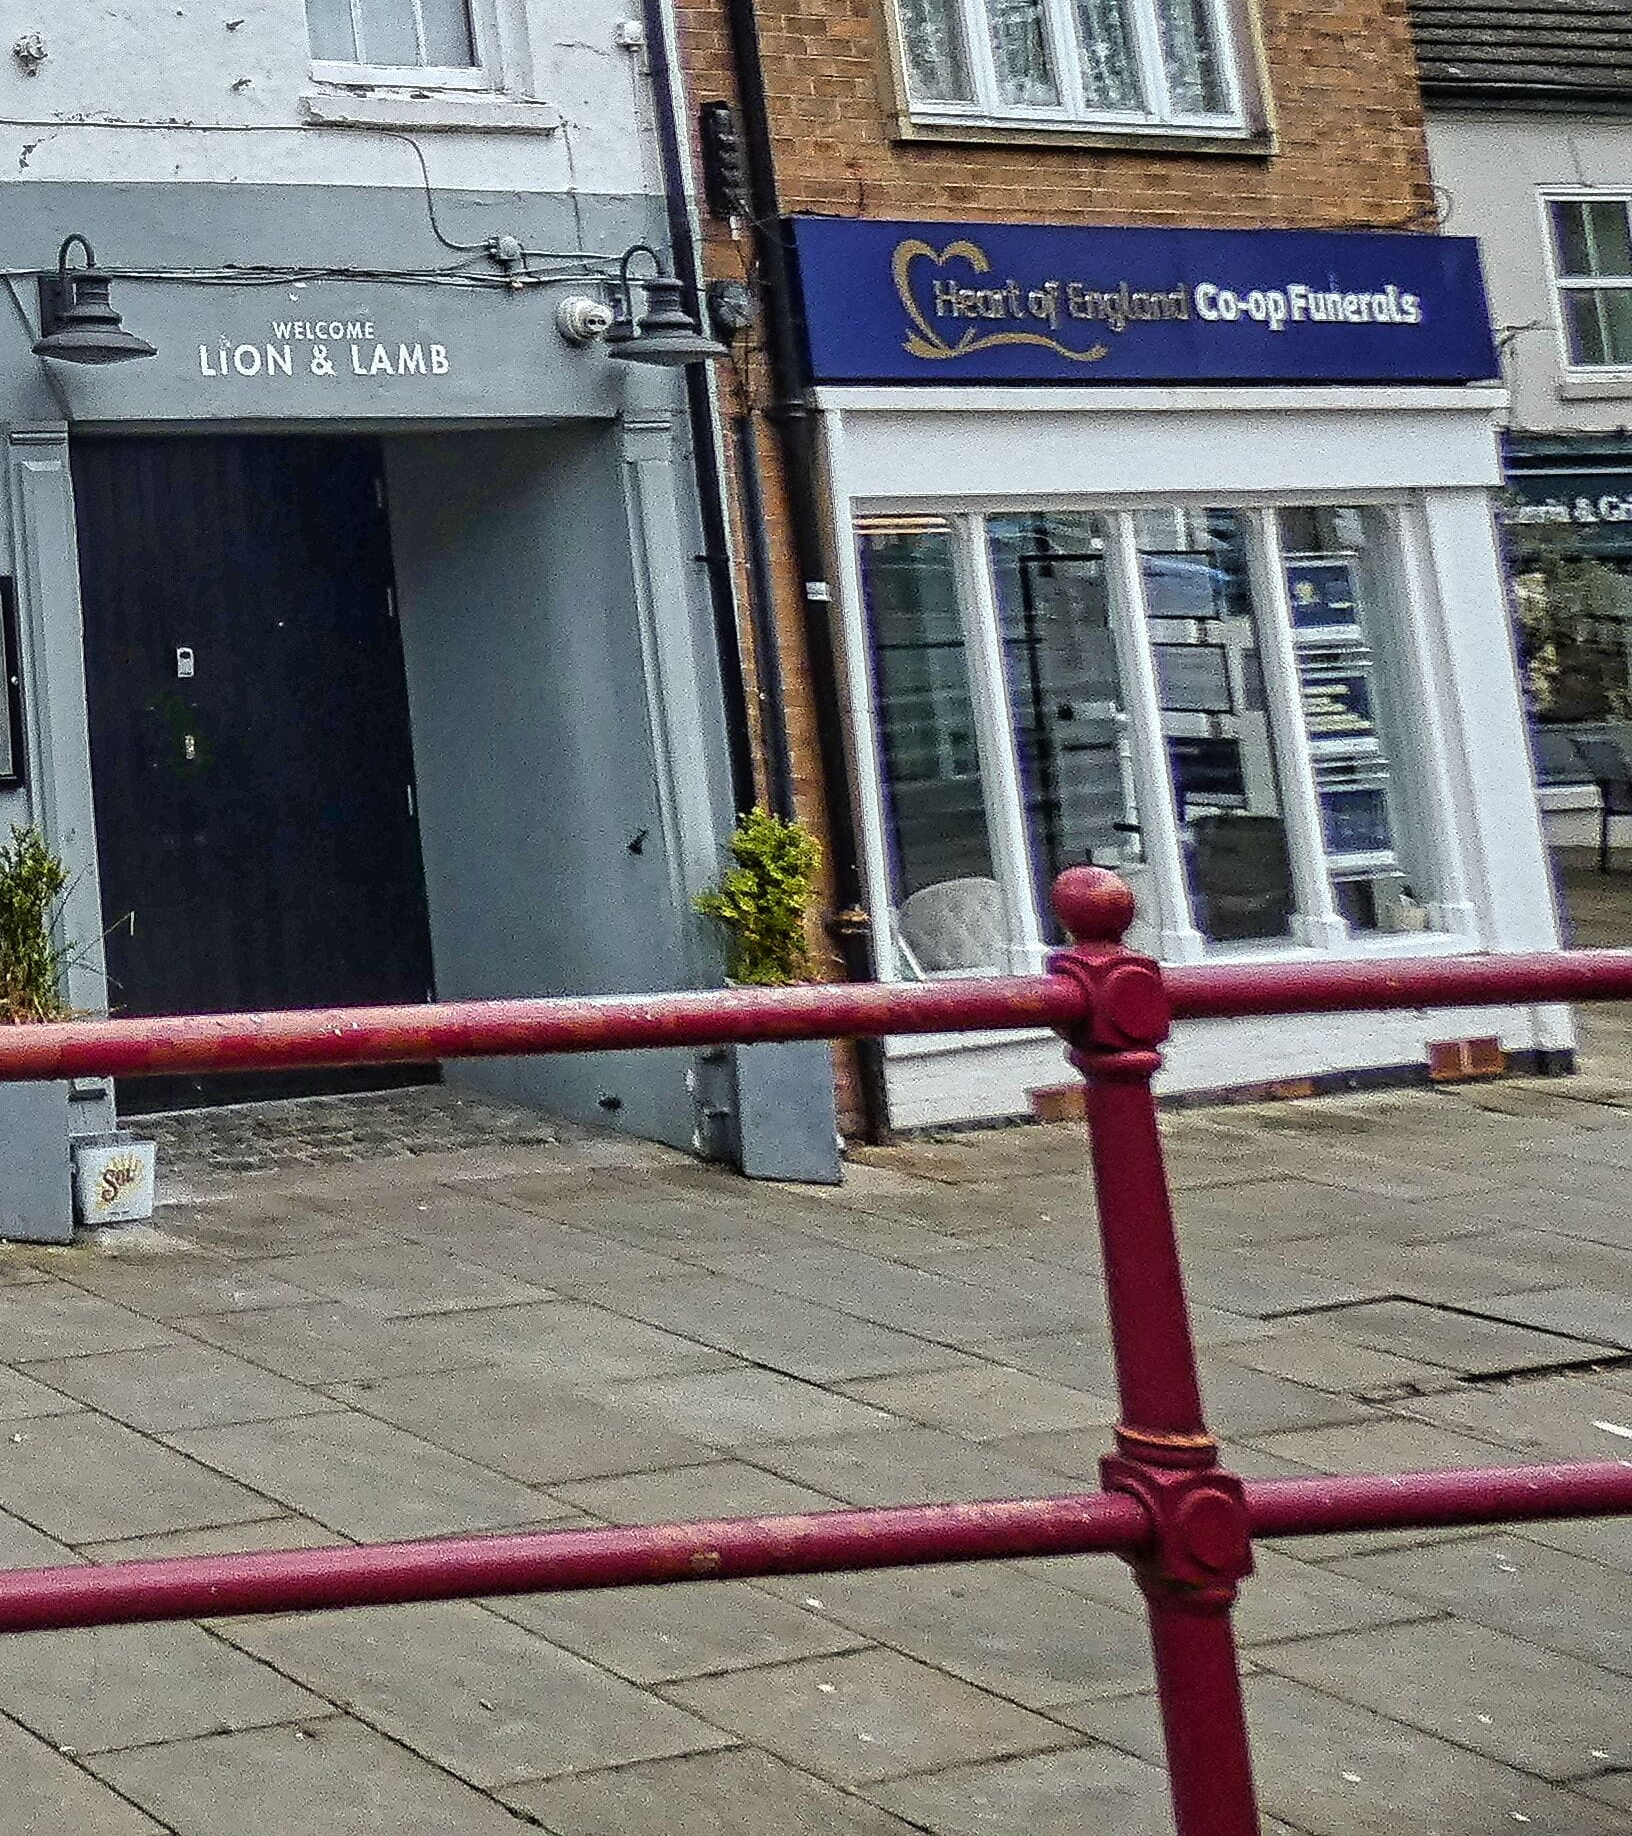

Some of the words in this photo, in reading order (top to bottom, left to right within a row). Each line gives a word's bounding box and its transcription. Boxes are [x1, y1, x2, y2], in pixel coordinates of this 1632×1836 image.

[933, 279, 1025, 318] Heart
[1028, 280, 1059, 330] of
[1066, 281, 1189, 332] England
[1194, 281, 1286, 330] Co-op
[1287, 283, 1422, 324] Funerals
[271, 320, 375, 340] WELCOME
[198, 343, 293, 377] LION
[310, 343, 336, 376] &
[350, 342, 451, 376] LAMB
